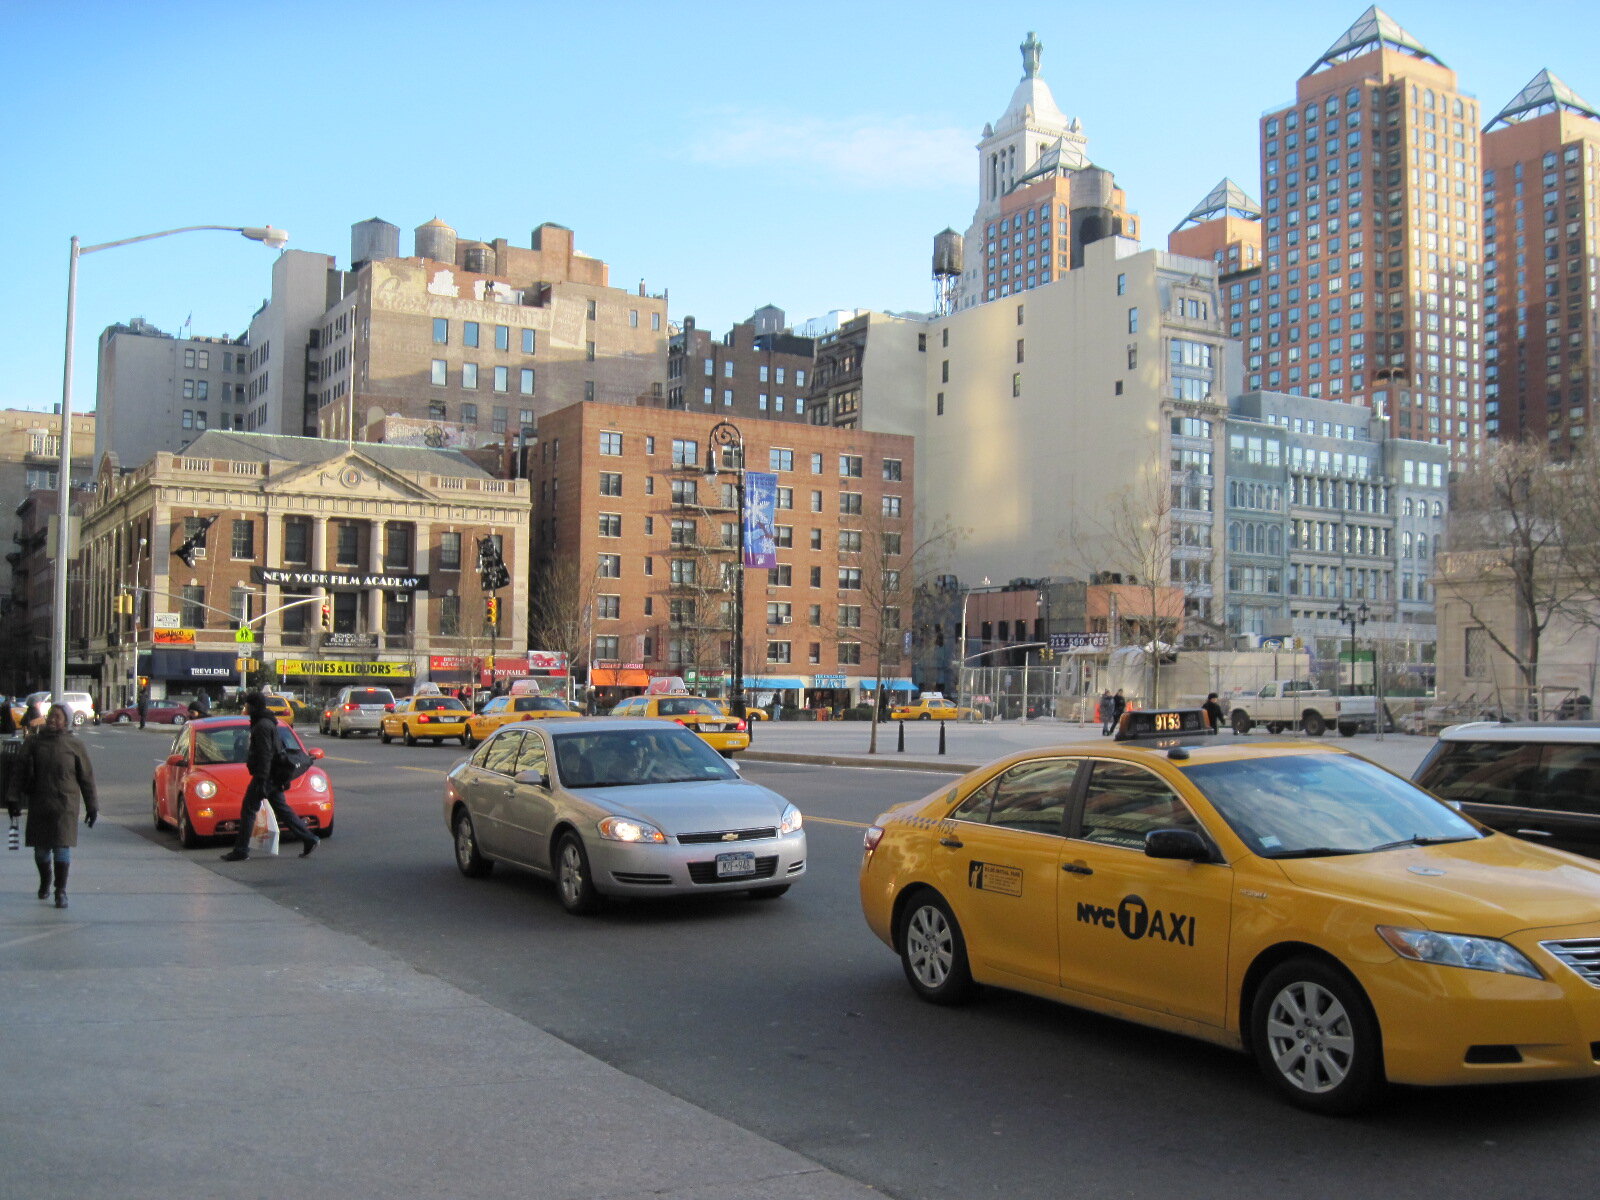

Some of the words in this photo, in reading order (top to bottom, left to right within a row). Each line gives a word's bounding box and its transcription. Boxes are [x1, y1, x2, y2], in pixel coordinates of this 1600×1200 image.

[263, 570, 291, 582] NEW
[295, 572, 328, 584] YORK
[331, 574, 360, 586] FILM
[363, 576, 420, 588] ACADEMY
[191, 667, 212, 675] TREVI
[213, 668, 230, 676] DELI
[300, 662, 336, 673] WINES
[337, 665, 344, 673] &
[345, 663, 391, 674] LIQUORS
[815, 679, 848, 688] PLACE
[1155, 713, 1181, 731] 9T53
[1077, 902, 1116, 929] NYC
[1118, 895, 1196, 947] TAXI
